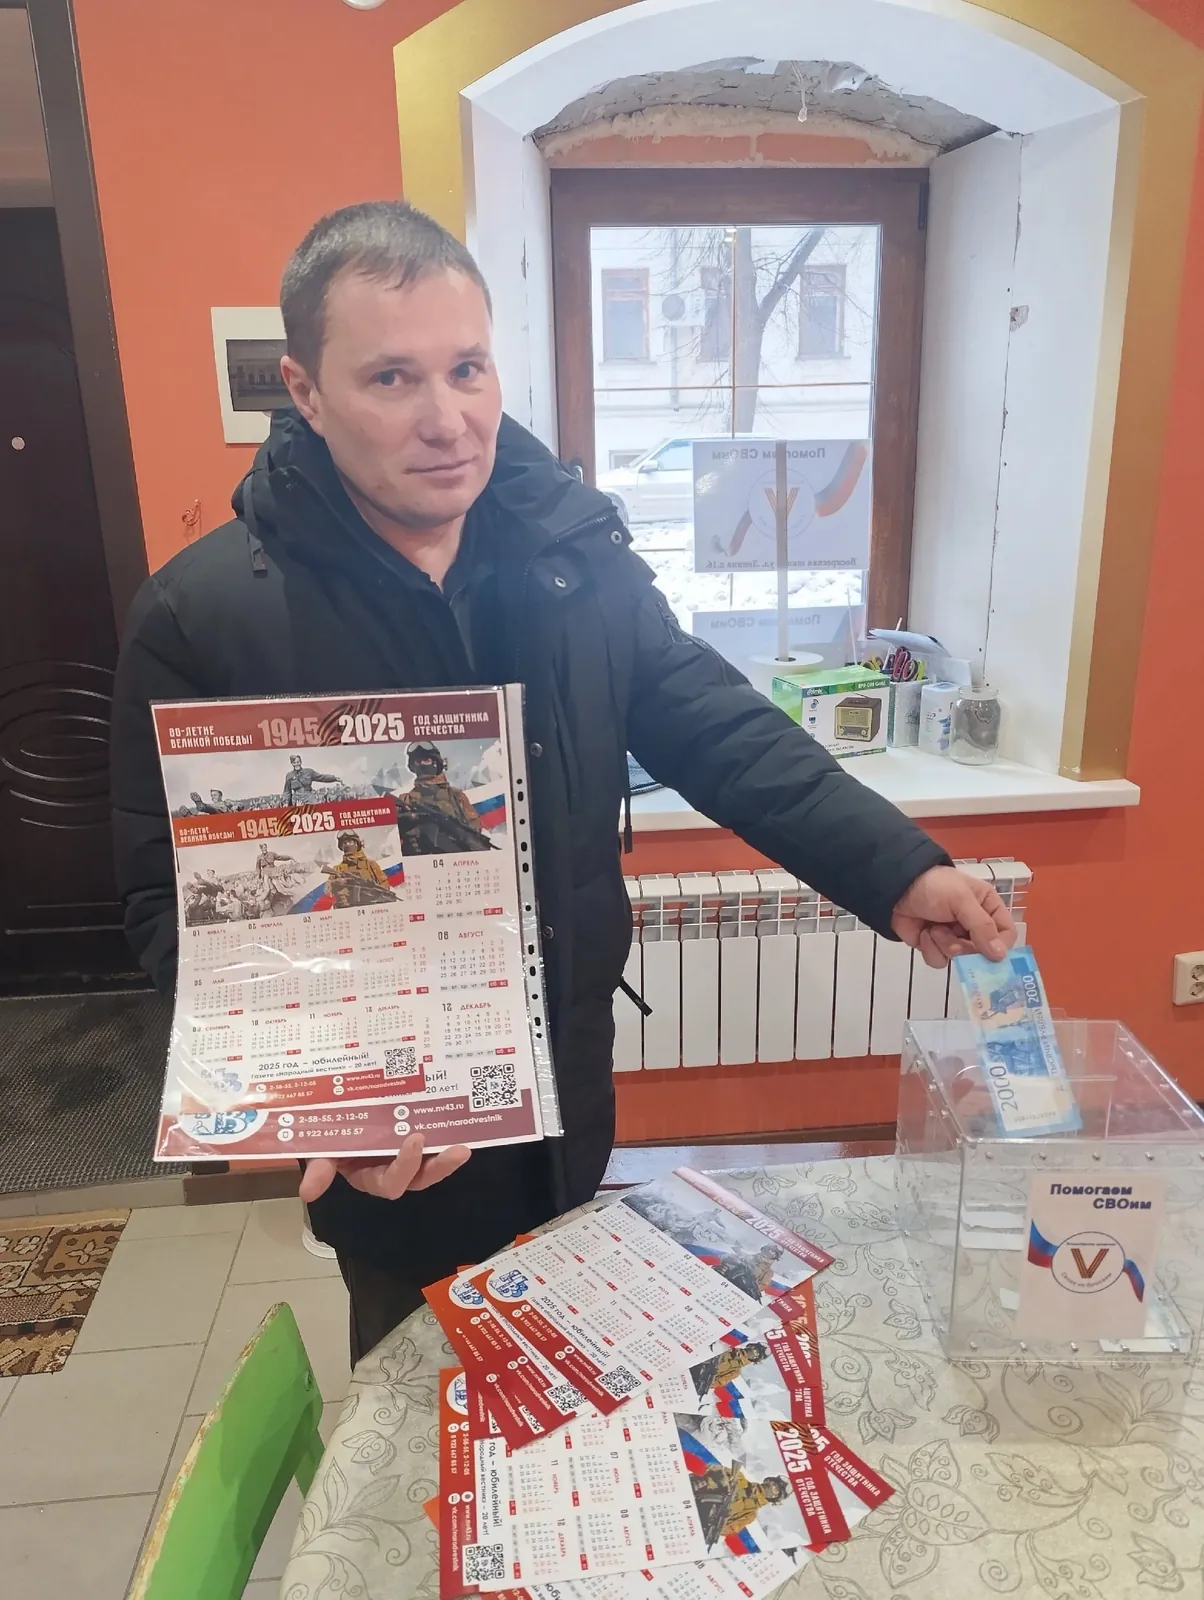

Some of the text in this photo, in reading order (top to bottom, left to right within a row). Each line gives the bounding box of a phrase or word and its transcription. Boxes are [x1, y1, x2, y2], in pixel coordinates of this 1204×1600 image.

[258, 712, 405, 747] 1945 2025
[413, 712, 489, 726] ГОД ЗАЩИТНИКА
[414, 724, 465, 736] ОТЕЧЕСТВА
[171, 734, 253, 749] ВЕЛИКОЙ ПОБЕДЫ!
[339, 807, 391, 819] ГОД ЗАЩИТНИКА
[340, 816, 376, 827] ОТЕЧЕСТВА
[237, 811, 335, 839] 1945 2025
[180, 831, 235, 843] ВЕЛИКОЙ ПОБЕДЫ!
[432, 859, 444, 868] 04
[458, 931, 484, 939] АВГУСТ
[1022, 975, 1040, 1004] 2000
[460, 1002, 491, 1011] ДЕКАБРЬ
[259, 1052, 370, 1071] 2025 год юбилейный!
[363, 1060, 377, 1068] лет!
[346, 1079, 407, 1093] vk.com/narodvestnik
[425, 1082, 459, 1094] 20 лет!
[989, 1066, 1018, 1112] 2000
[299, 1112, 368, 1124] 2-58-55, 2-12-05
[413, 1102, 465, 1115] www.nv43.ru
[306, 1129, 322, 1137] 922
[324, 1128, 339, 1137] 667
[341, 1127, 352, 1136] 85
[353, 1127, 364, 1136] 57
[414, 1113, 503, 1131] vk.com/narodvestnik
[1050, 1184, 1132, 1195] Помогаем
[1093, 1198, 1152, 1210] СВОим
[745, 1215, 784, 1242] 2025
[794, 1242, 825, 1264] ЗАЩИТНИКА
[529, 1312, 558, 1339] 2-58-55, 2-12-05
[541, 1296, 611, 1359] 2025 год юбилейный!
[498, 1332, 513, 1348] 2-12-05
[589, 1351, 597, 1360] 20
[596, 1358, 607, 1368] лет!
[773, 1343, 792, 1373] ОТЕЧЕСТВА
[780, 1341, 789, 1352] ГОД
[786, 1351, 806, 1385] ЗАЩИТНИКА
[564, 1359, 605, 1397] vk.com/narodvestnik
[515, 1369, 552, 1411] vk.com/narodvestnik
[610, 1451, 619, 1459] 07
[669, 1443, 678, 1452] 03
[775, 1428, 812, 1473] 2025
[824, 1455, 859, 1488] ОТЕЧЕСТВА
[830, 1450, 881, 1497] ГОД ЗАЩИТНИКА
[480, 1472, 490, 1536] вестник» 20 лет!
[490, 1469, 502, 1528] юбилейный!
[795, 1478, 816, 1518] ОТЕЧЕСТВА
[805, 1477, 832, 1535] ГОД ЗАЩИТНИКА
[465, 1504, 473, 1541] www.nv43.ru
[620, 1509, 632, 1547] 08 АВГУСТ
[682, 1499, 696, 1537] 04 АПРЕЛЬ
[451, 1506, 461, 1572] vk.com/narodvestnik
[558, 1532, 566, 1557] ДЕКАБРЬ
[705, 1574, 726, 1595] АВГУСТ
